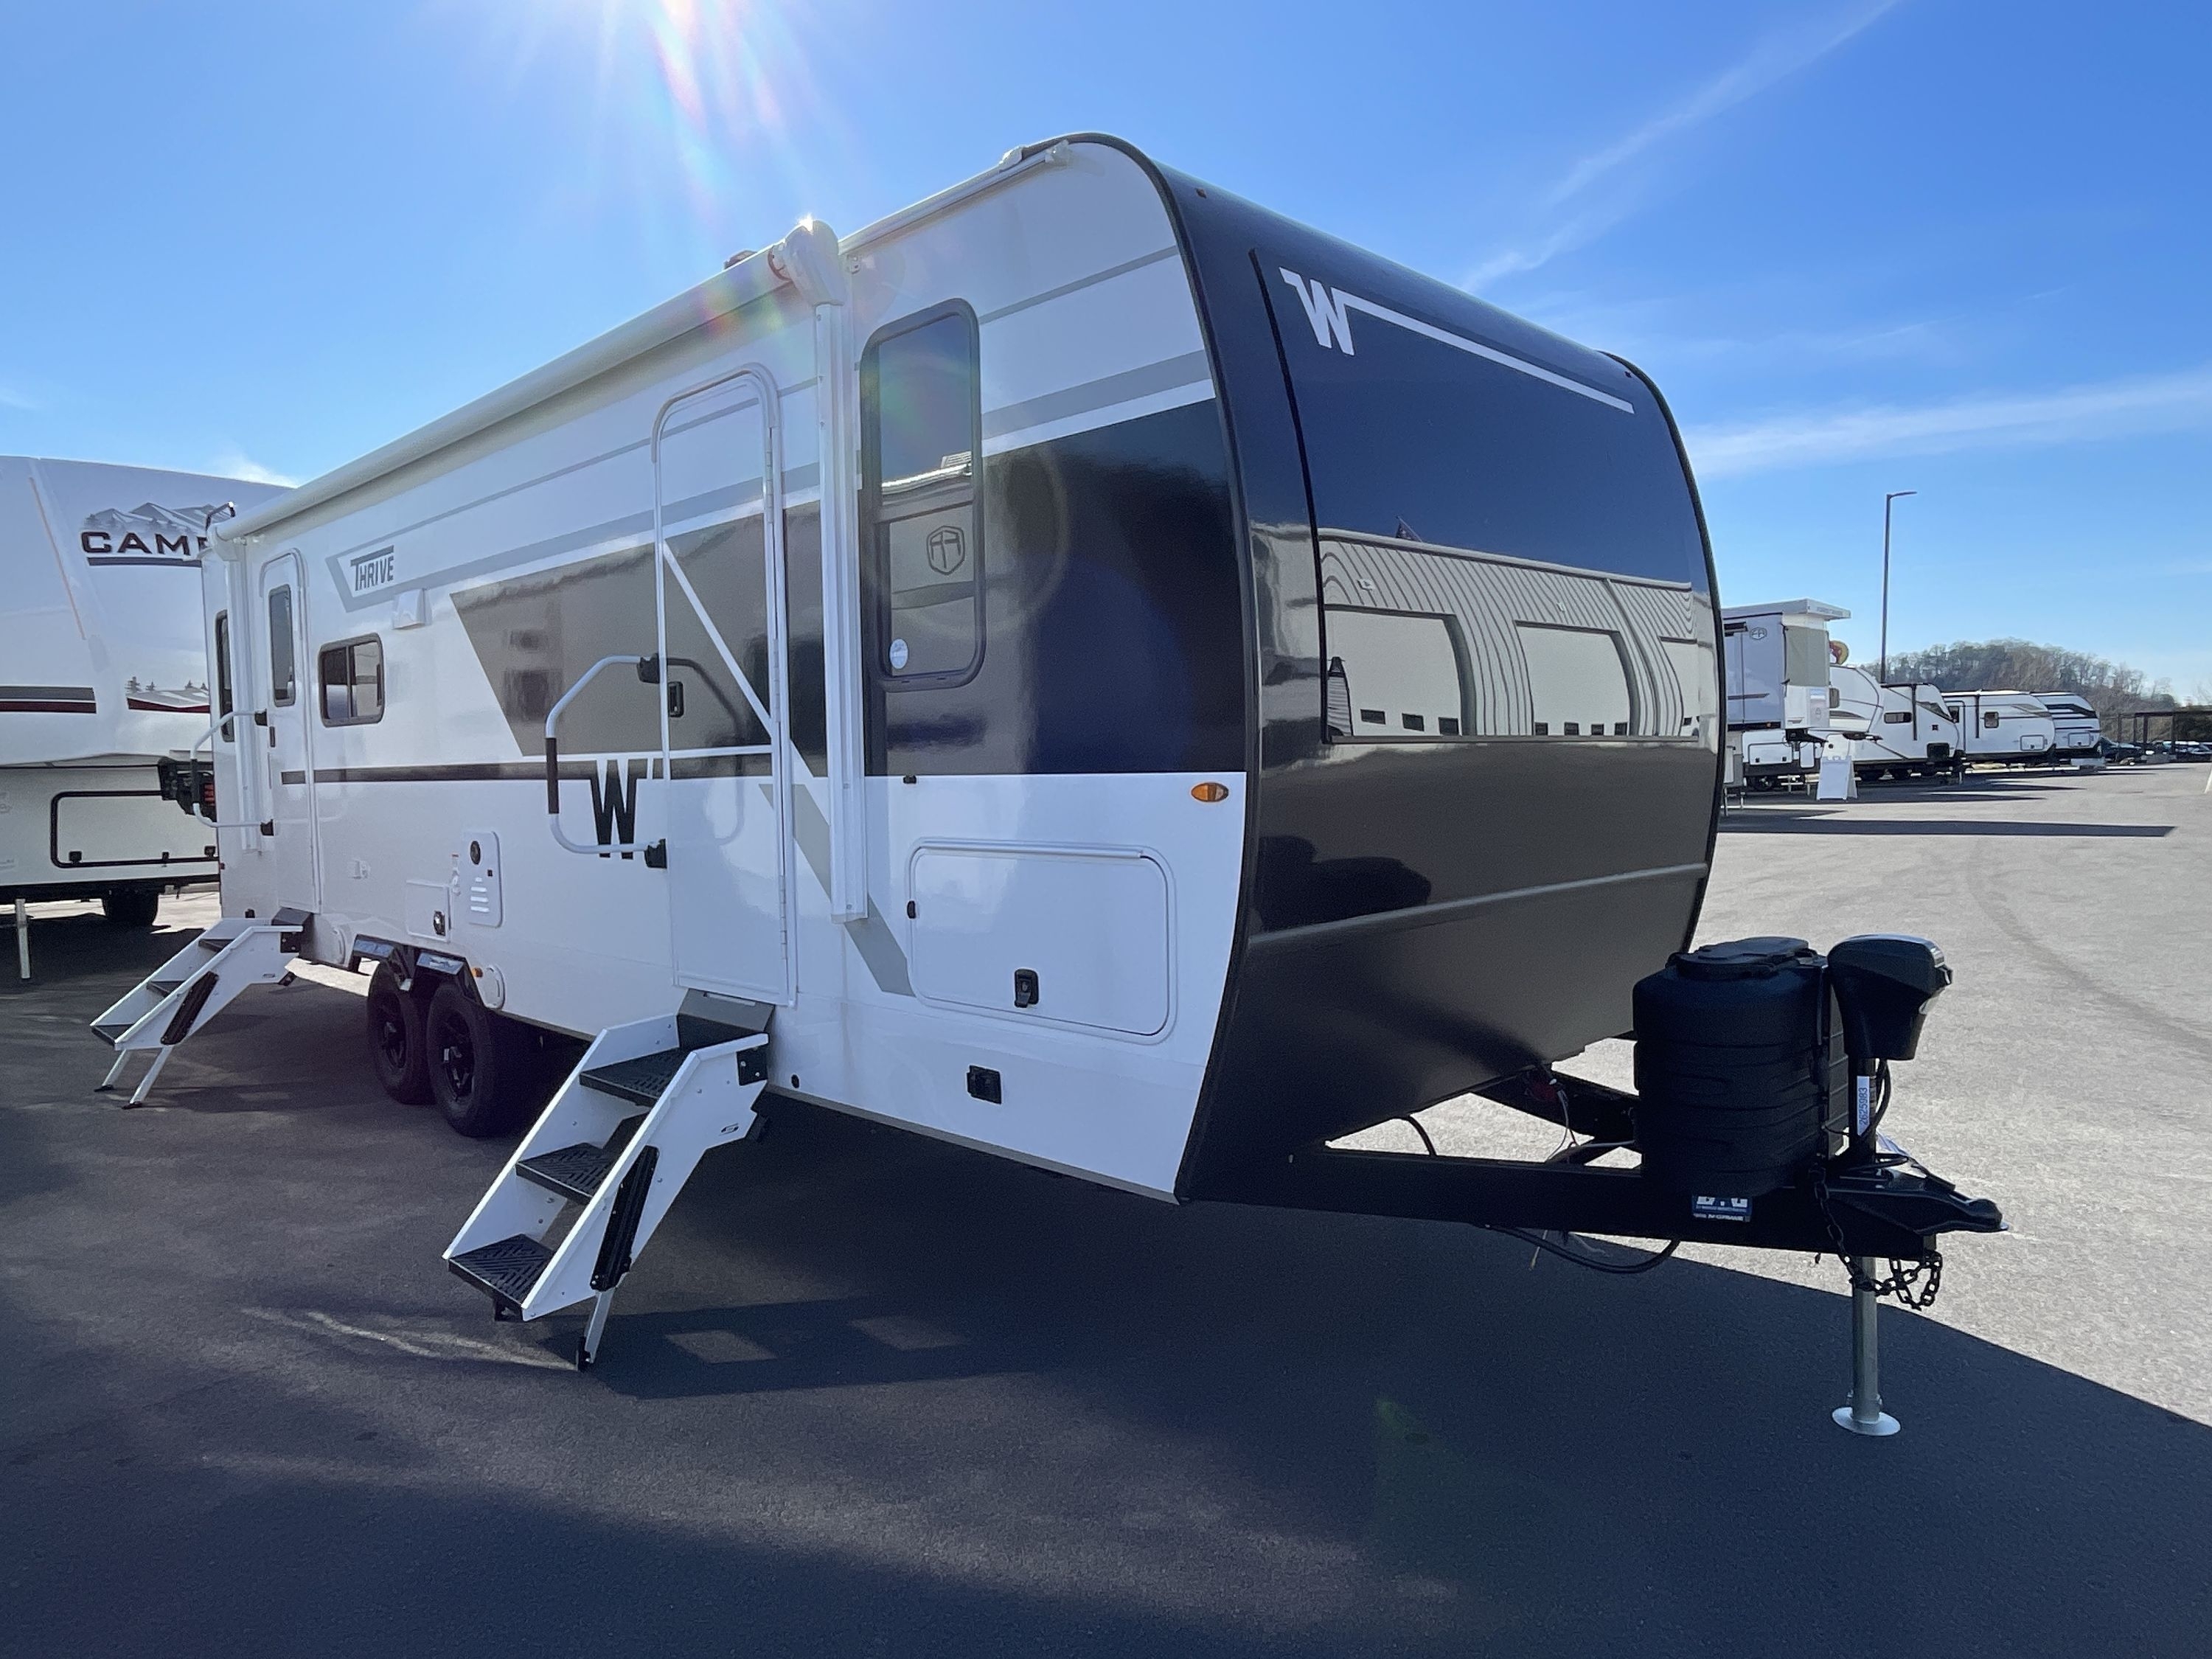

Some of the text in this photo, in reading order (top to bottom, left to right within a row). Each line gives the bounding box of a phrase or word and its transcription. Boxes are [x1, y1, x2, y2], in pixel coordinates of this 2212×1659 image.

[1279, 266, 1355, 355] W
[350, 545, 394, 591] THRIVE
[589, 759, 637, 860] W
